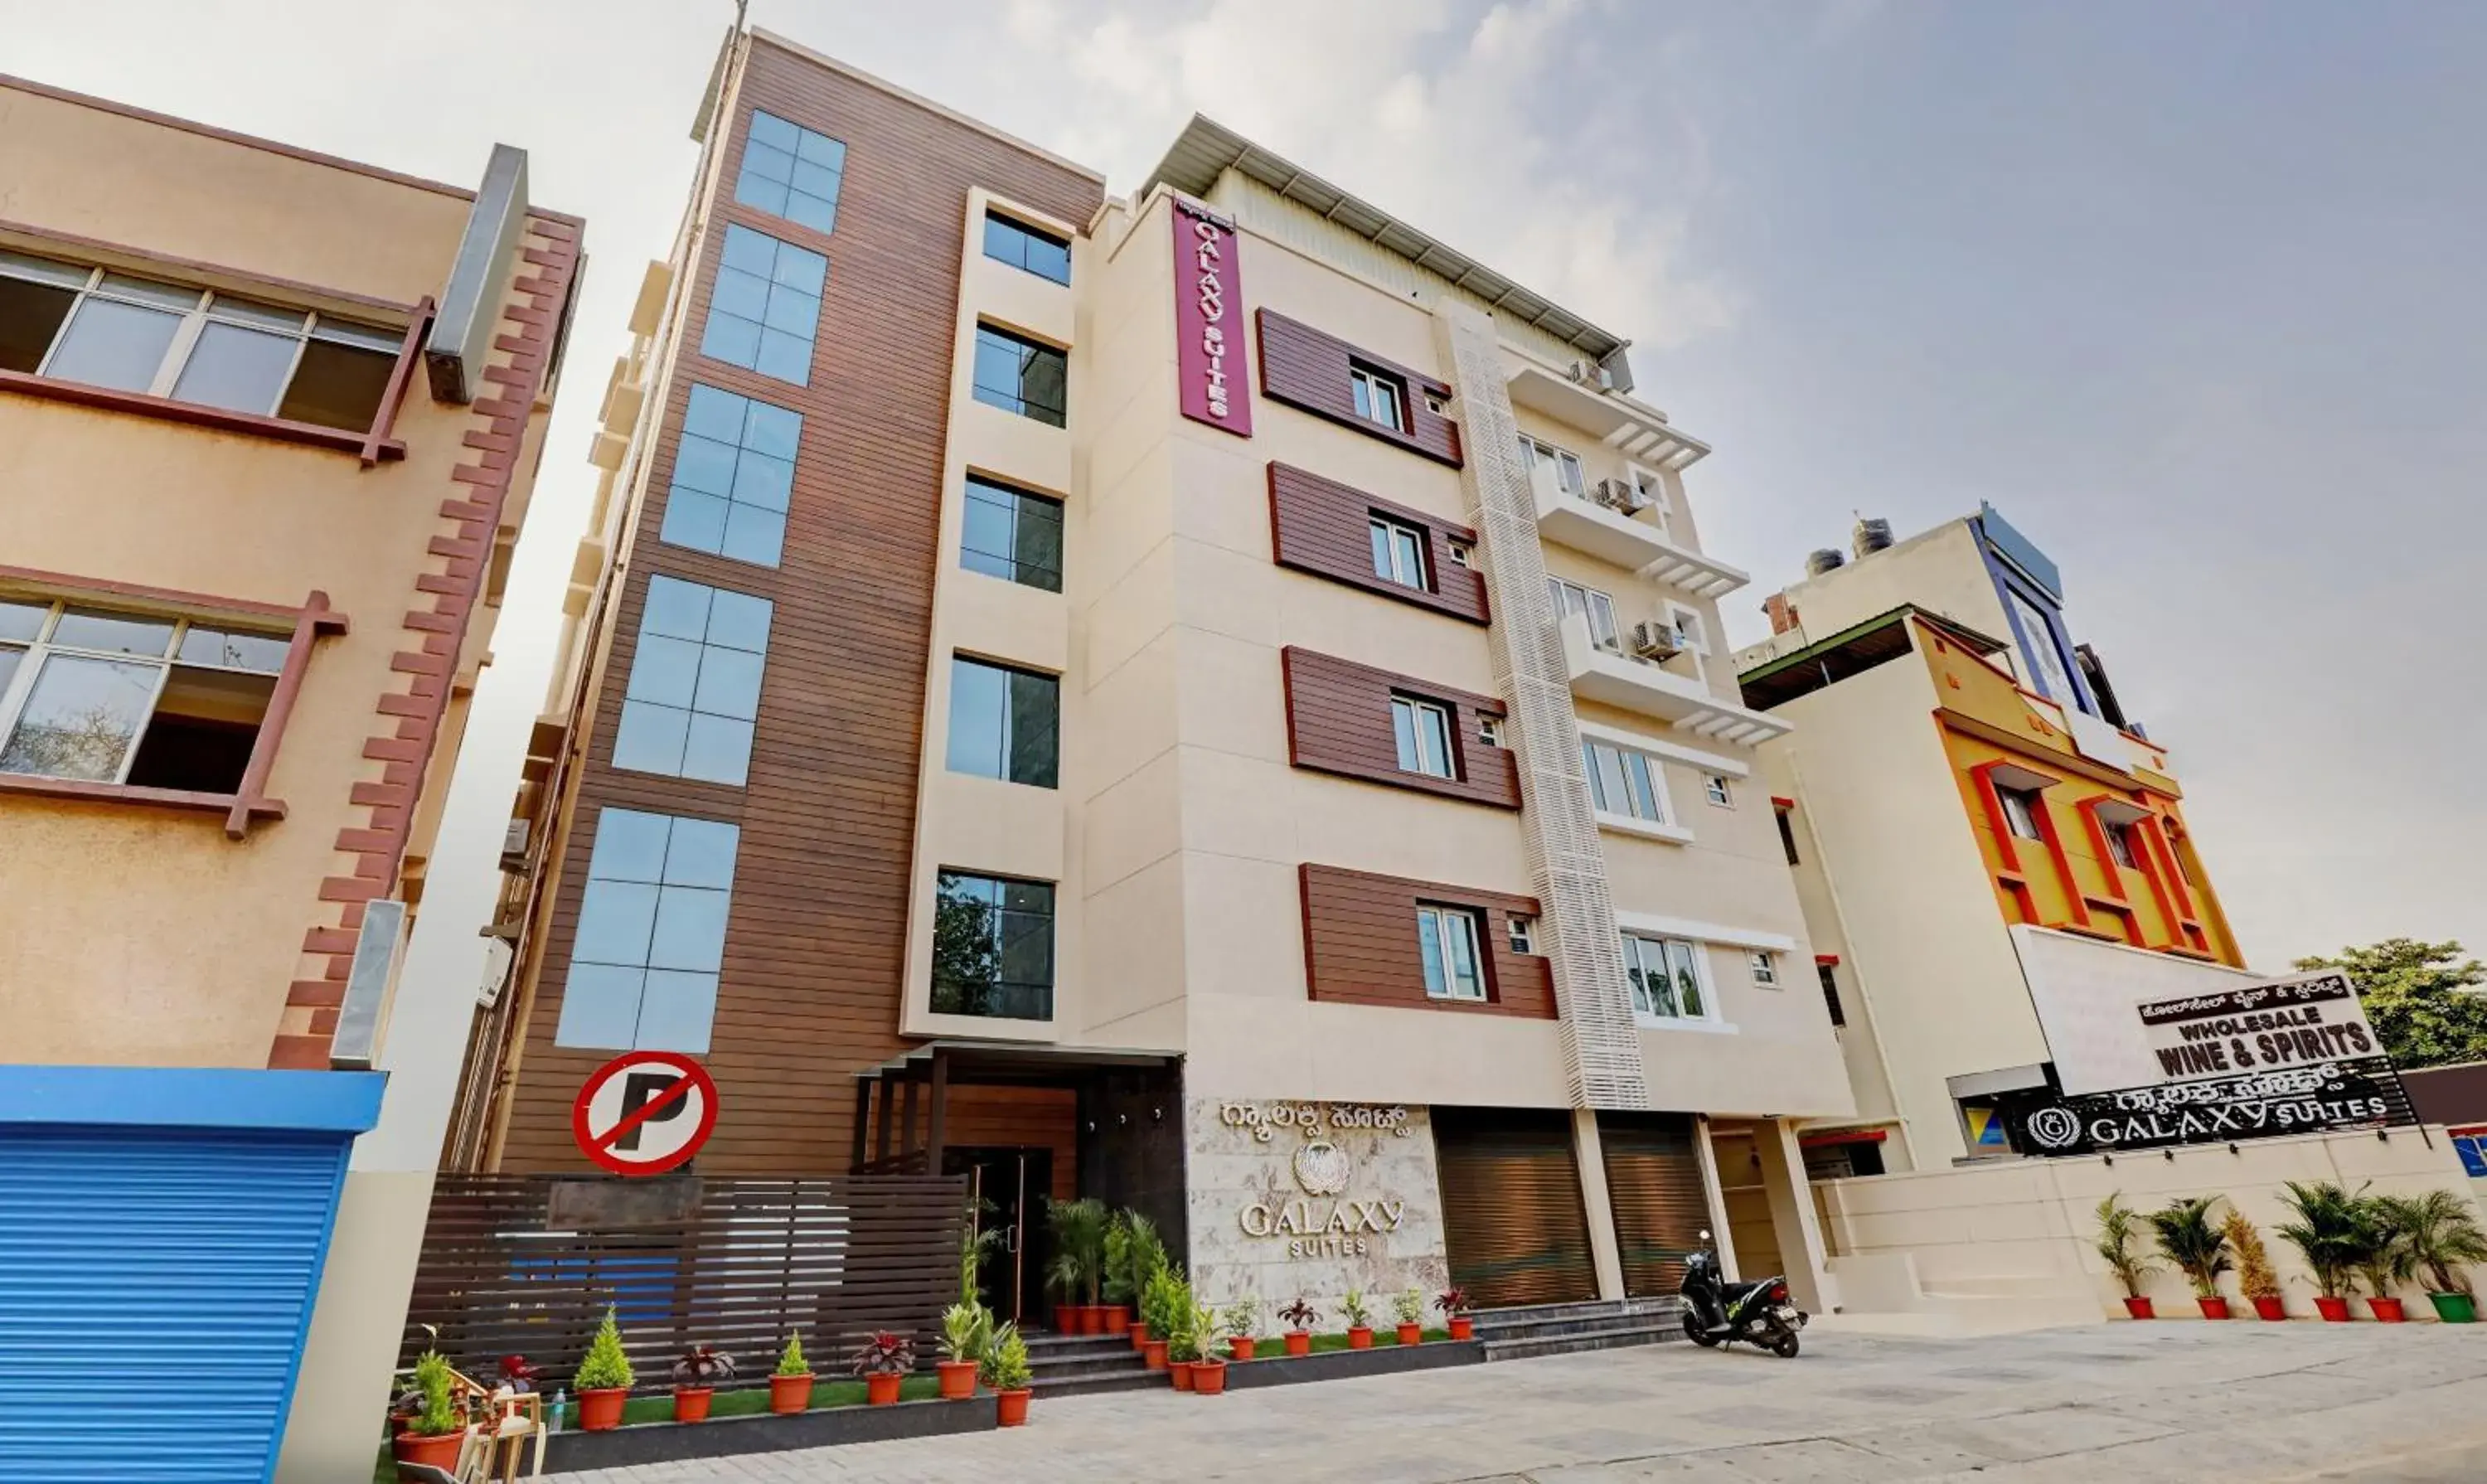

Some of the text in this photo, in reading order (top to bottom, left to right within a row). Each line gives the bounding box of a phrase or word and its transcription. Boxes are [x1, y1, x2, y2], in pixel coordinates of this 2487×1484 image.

[1203, 326, 1228, 418] SUITES
[2179, 1006, 2323, 1041] WHOLESALE
[2155, 1021, 2372, 1077] WINE & SPIRITS
[614, 1073, 689, 1151] P
[2090, 1097, 2388, 1142] GALAXY SUITES
[1240, 1201, 1404, 1237] GALAXY
[1290, 1239, 1367, 1257] SUITES
